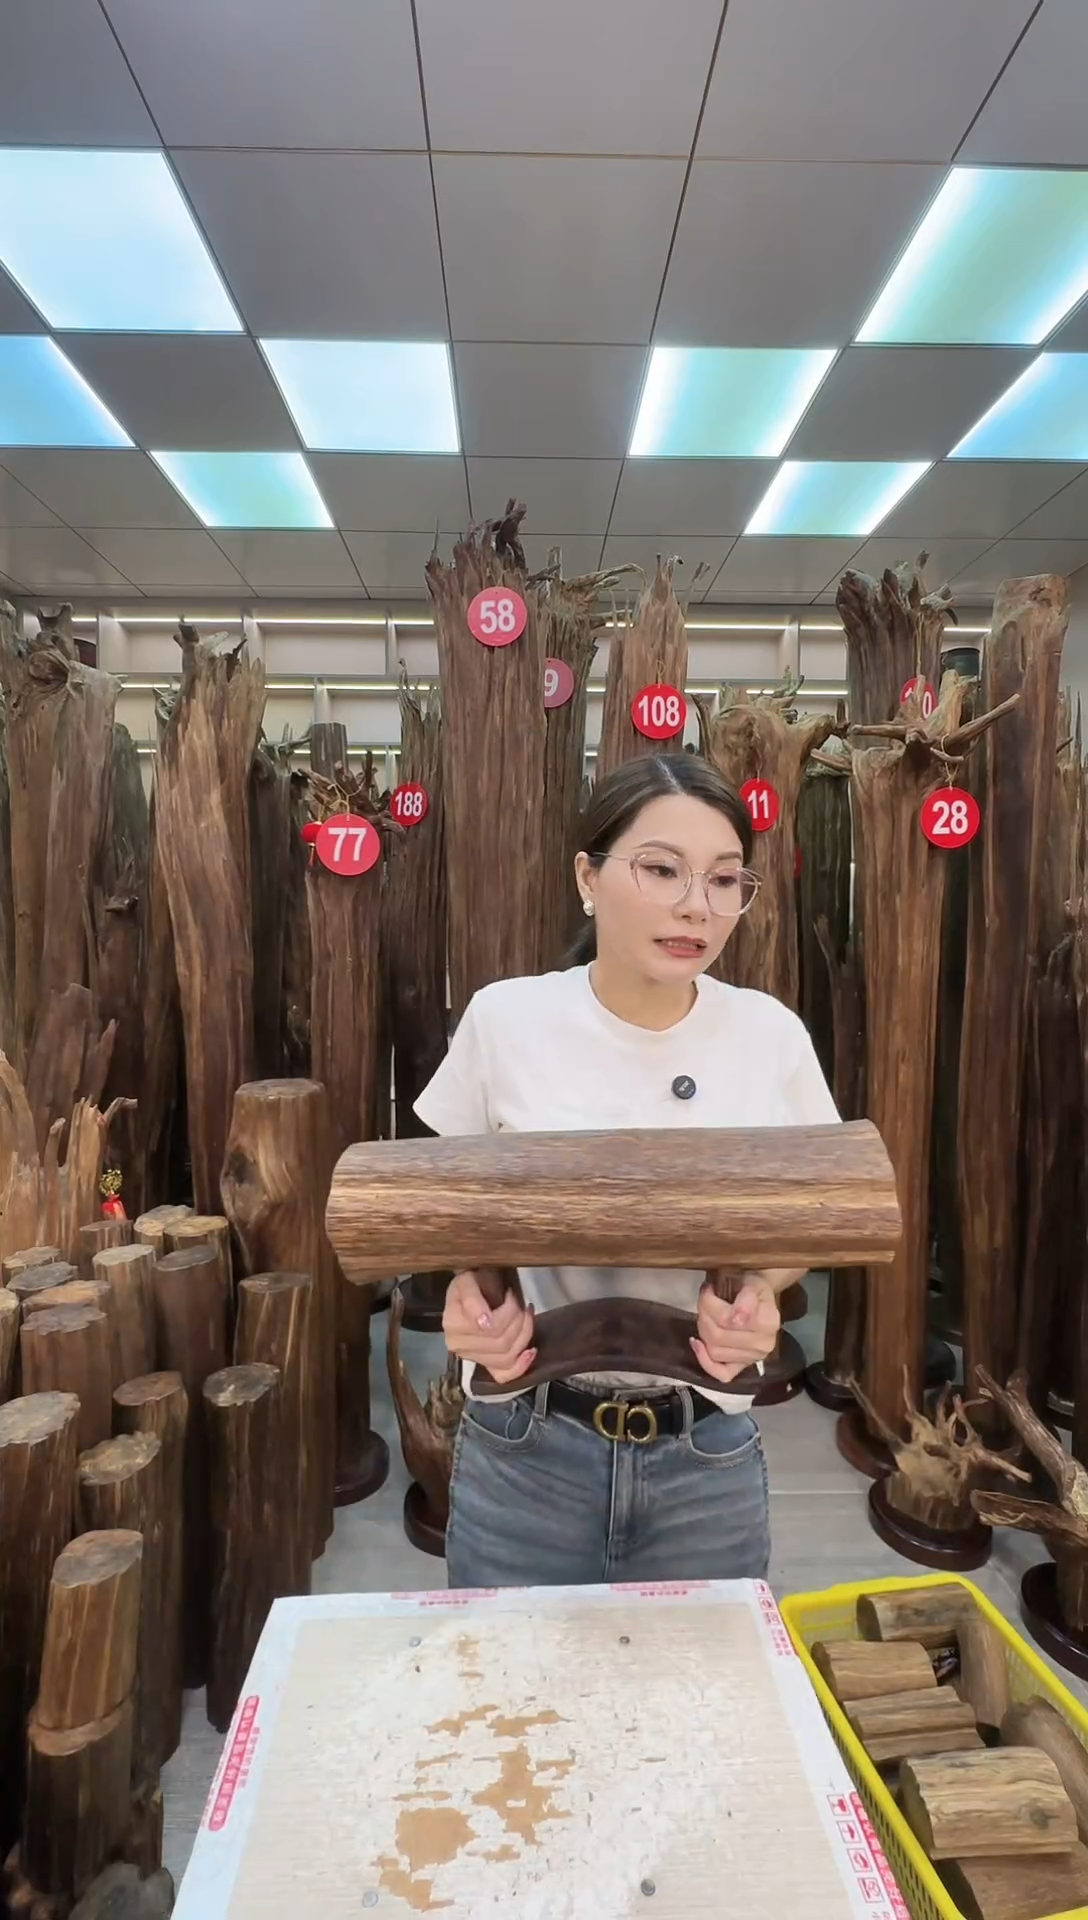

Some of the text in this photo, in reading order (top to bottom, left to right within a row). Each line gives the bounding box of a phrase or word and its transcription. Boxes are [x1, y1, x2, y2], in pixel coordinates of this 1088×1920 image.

[480, 599, 516, 634] 58
[638, 695, 680, 727] 108
[395, 791, 423, 817] 188
[747, 789, 769, 819] 11
[932, 800, 969, 835] 28
[328, 827, 367, 862] 77
